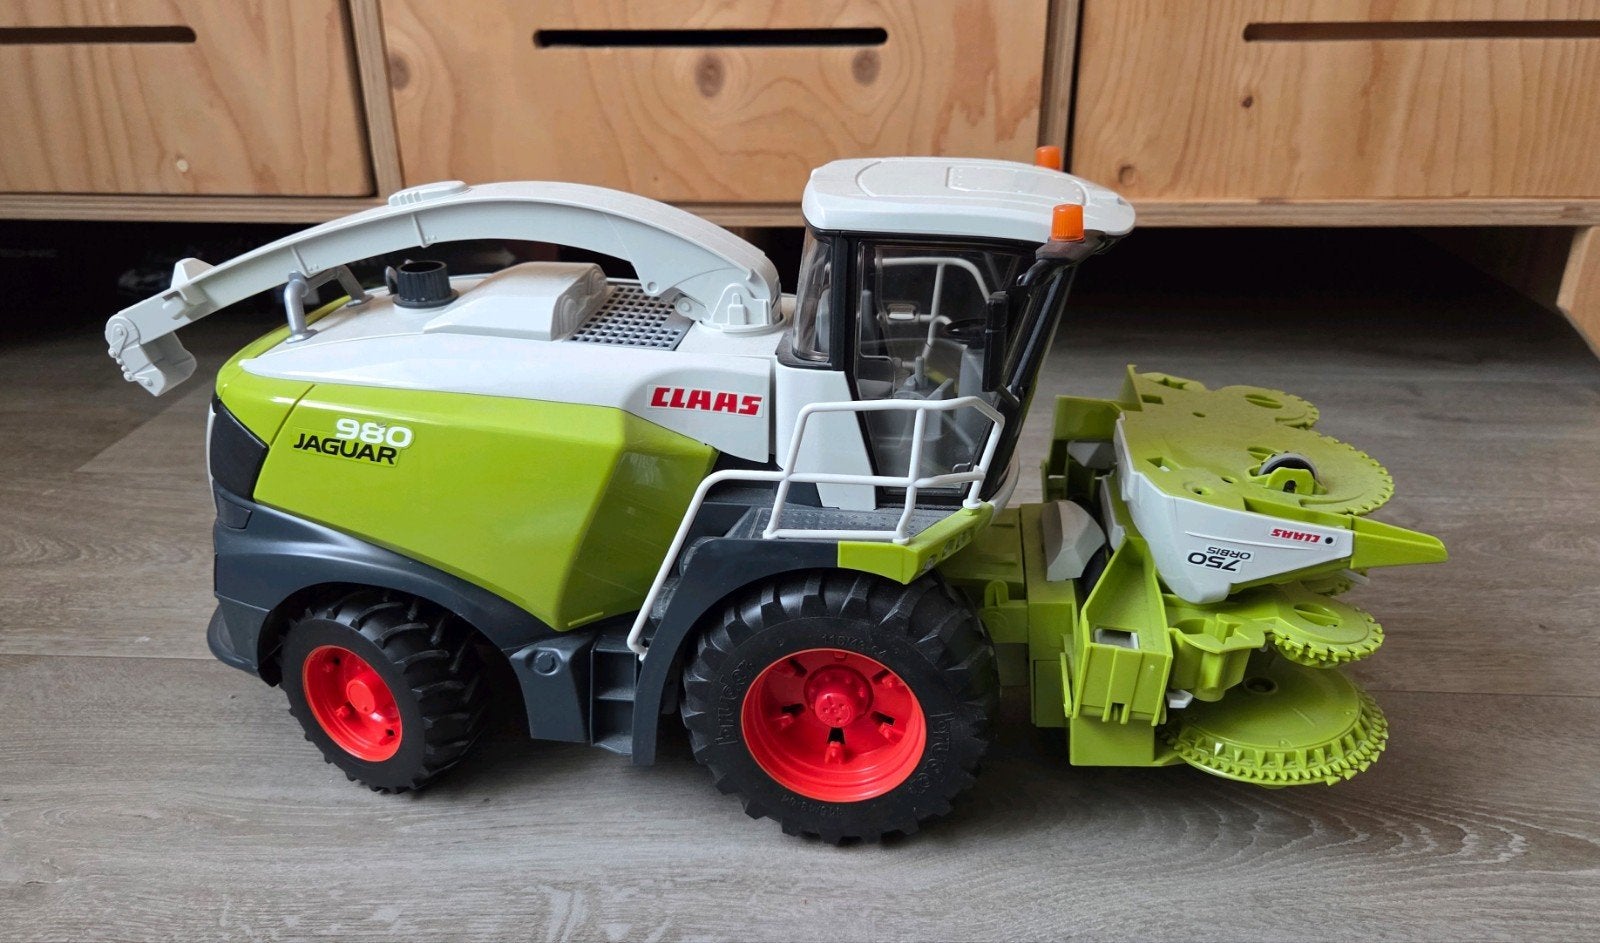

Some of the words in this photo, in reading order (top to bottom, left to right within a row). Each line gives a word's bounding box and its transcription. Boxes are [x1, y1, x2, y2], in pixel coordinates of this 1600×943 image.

[651, 387, 762, 416] CLAAS
[336, 418, 412, 448] 980
[294, 433, 398, 465] JAGUAR
[1271, 528, 1321, 543] CLAAS
[1187, 551, 1241, 572] 750
[1206, 546, 1251, 560] ORBIS
